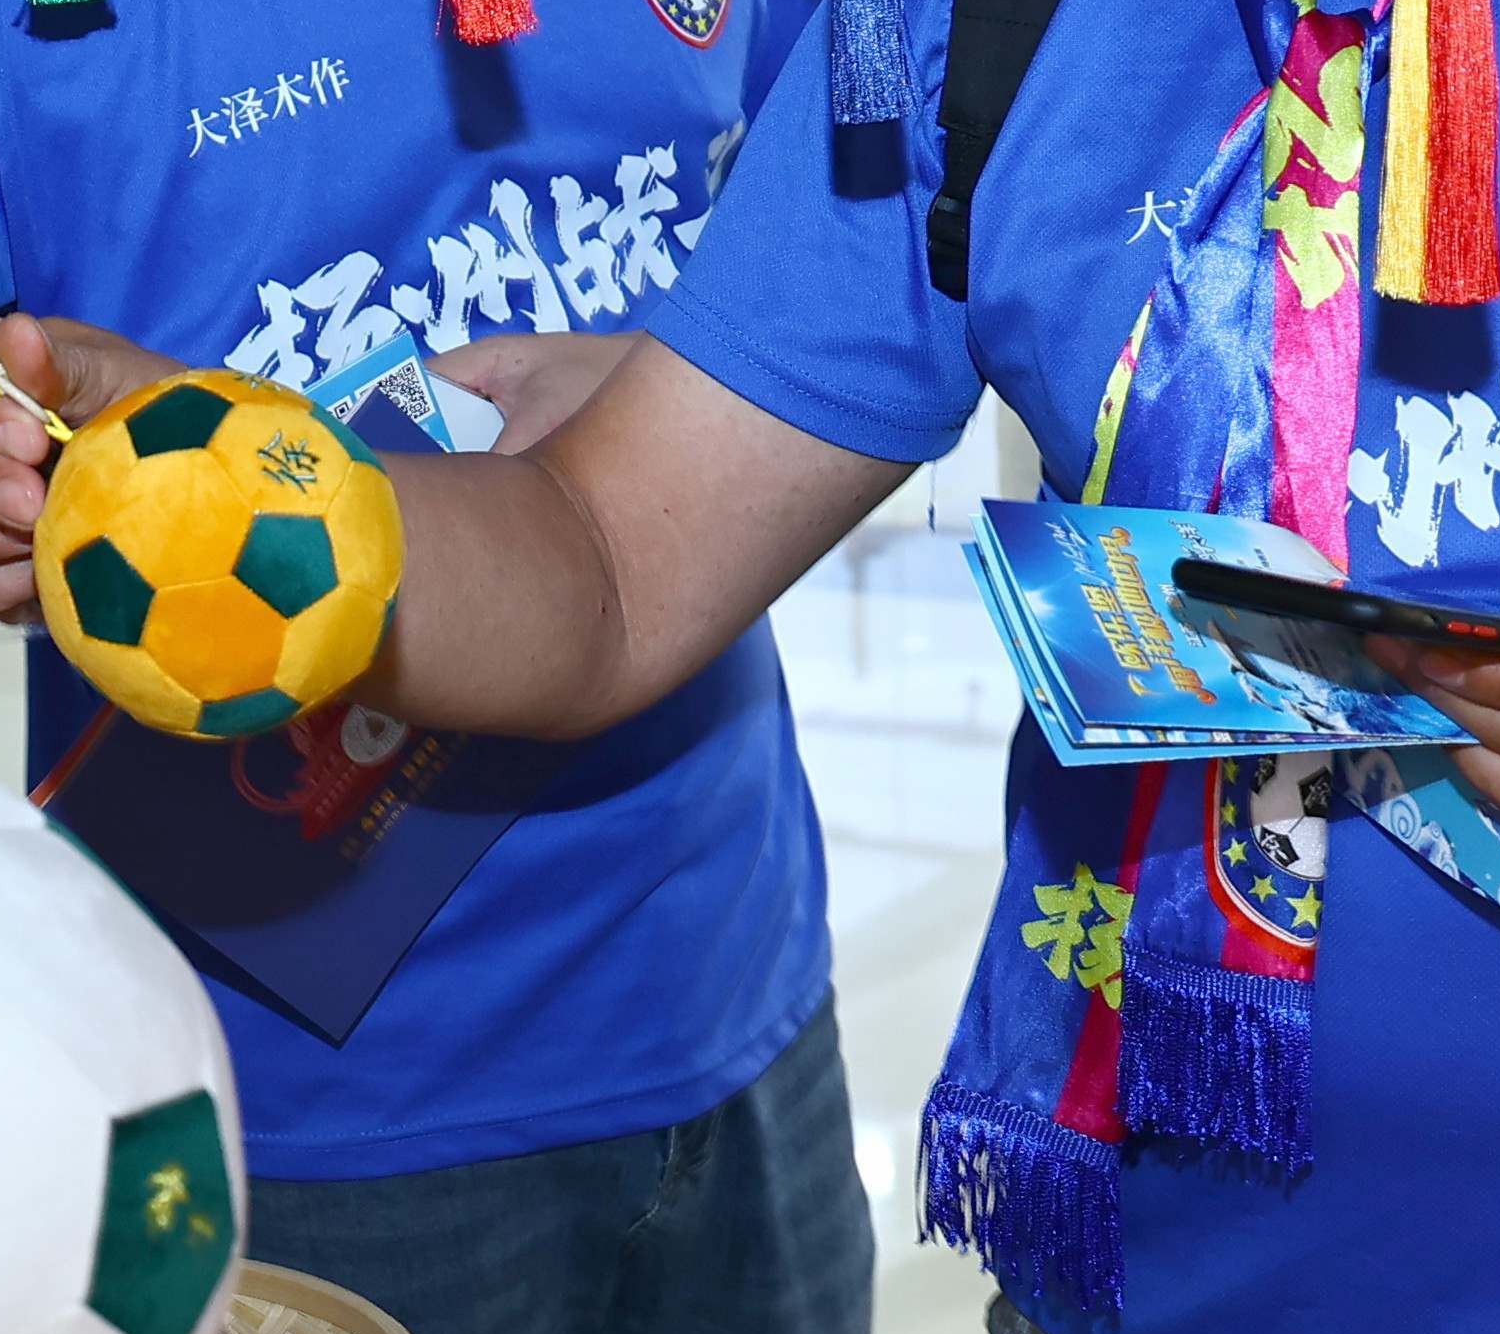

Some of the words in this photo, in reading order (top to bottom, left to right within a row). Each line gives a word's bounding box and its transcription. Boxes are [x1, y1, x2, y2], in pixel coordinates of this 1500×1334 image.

[185, 56, 351, 160] 大泽木作
[1082, 582, 1151, 673] 欧乐堡
[1096, 525, 1218, 707] 海洋极地世界
